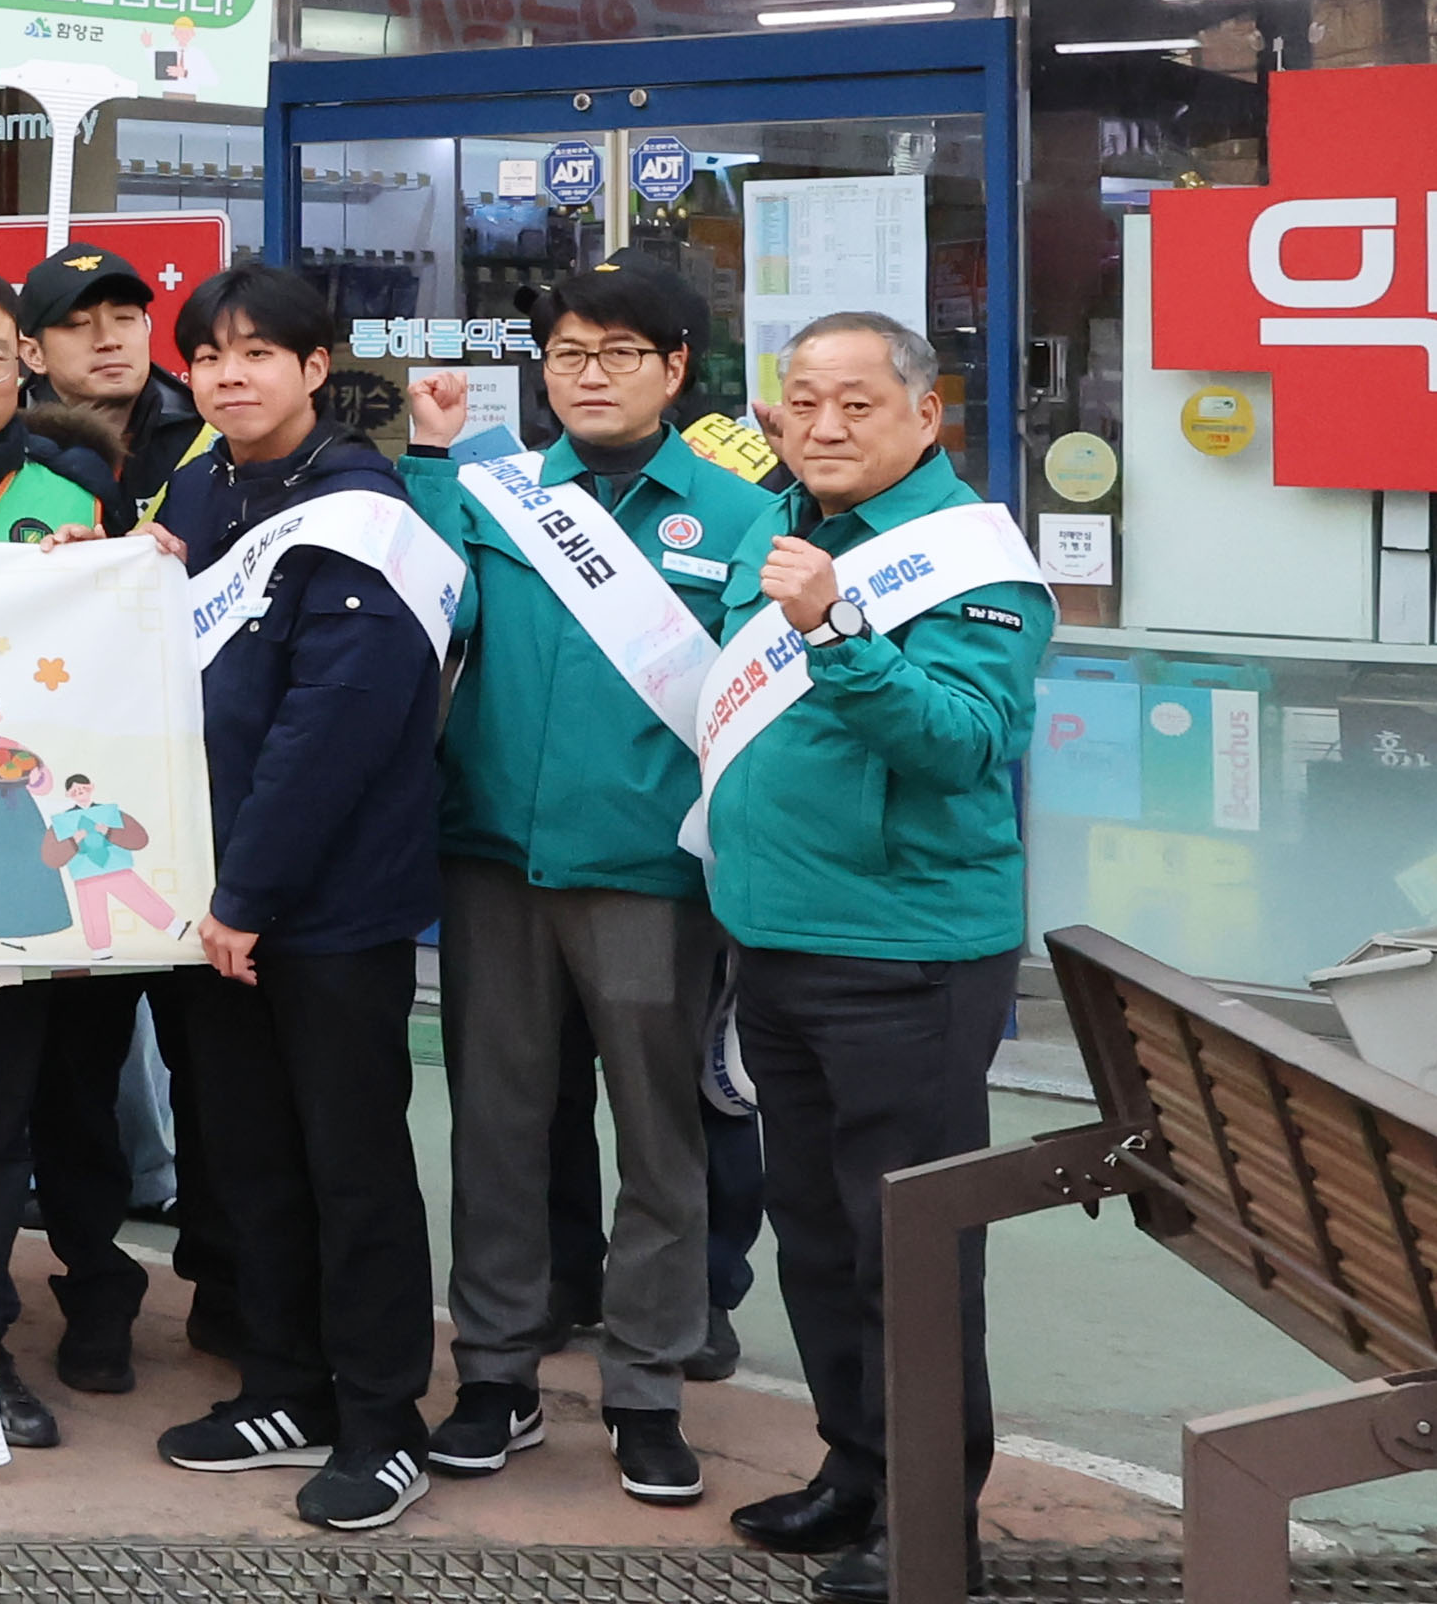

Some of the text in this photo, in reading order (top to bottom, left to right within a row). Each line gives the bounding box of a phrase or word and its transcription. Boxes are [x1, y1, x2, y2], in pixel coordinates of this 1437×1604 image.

[56, 22, 105, 43] 함양군
[551, 158, 594, 184] ADT
[639, 155, 684, 181] ADT
[349, 316, 542, 360] 동해물약국
[536, 510, 617, 591] 대국민
[869, 551, 935, 602] 생활
[193, 572, 245, 640] 안전문
